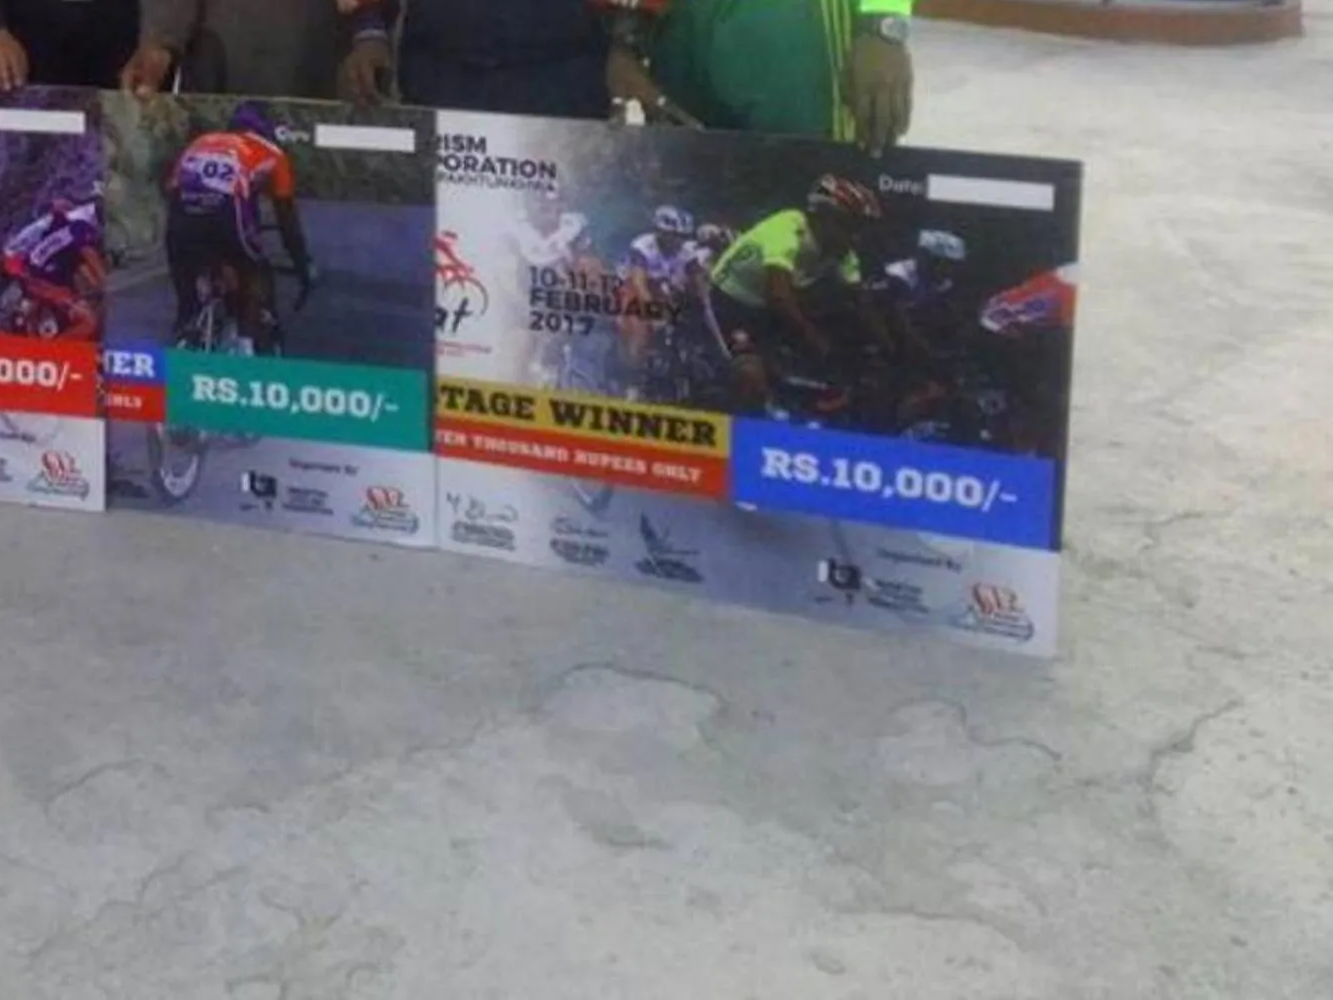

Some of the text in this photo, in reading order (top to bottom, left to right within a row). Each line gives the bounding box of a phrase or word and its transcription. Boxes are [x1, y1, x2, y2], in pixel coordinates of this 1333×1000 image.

[435, 133, 487, 154] ISM
[203, 158, 234, 181] 02
[436, 154, 557, 179] ORATION
[529, 310, 596, 336] 2017
[192, 373, 400, 423] RS.10,000/-
[548, 399, 716, 447] WINNER
[472, 435, 568, 463] THOUSAND
[574, 449, 646, 475] RUPEES
[651, 466, 702, 483] ONLY
[761, 446, 1018, 512] RS.10,000/-
